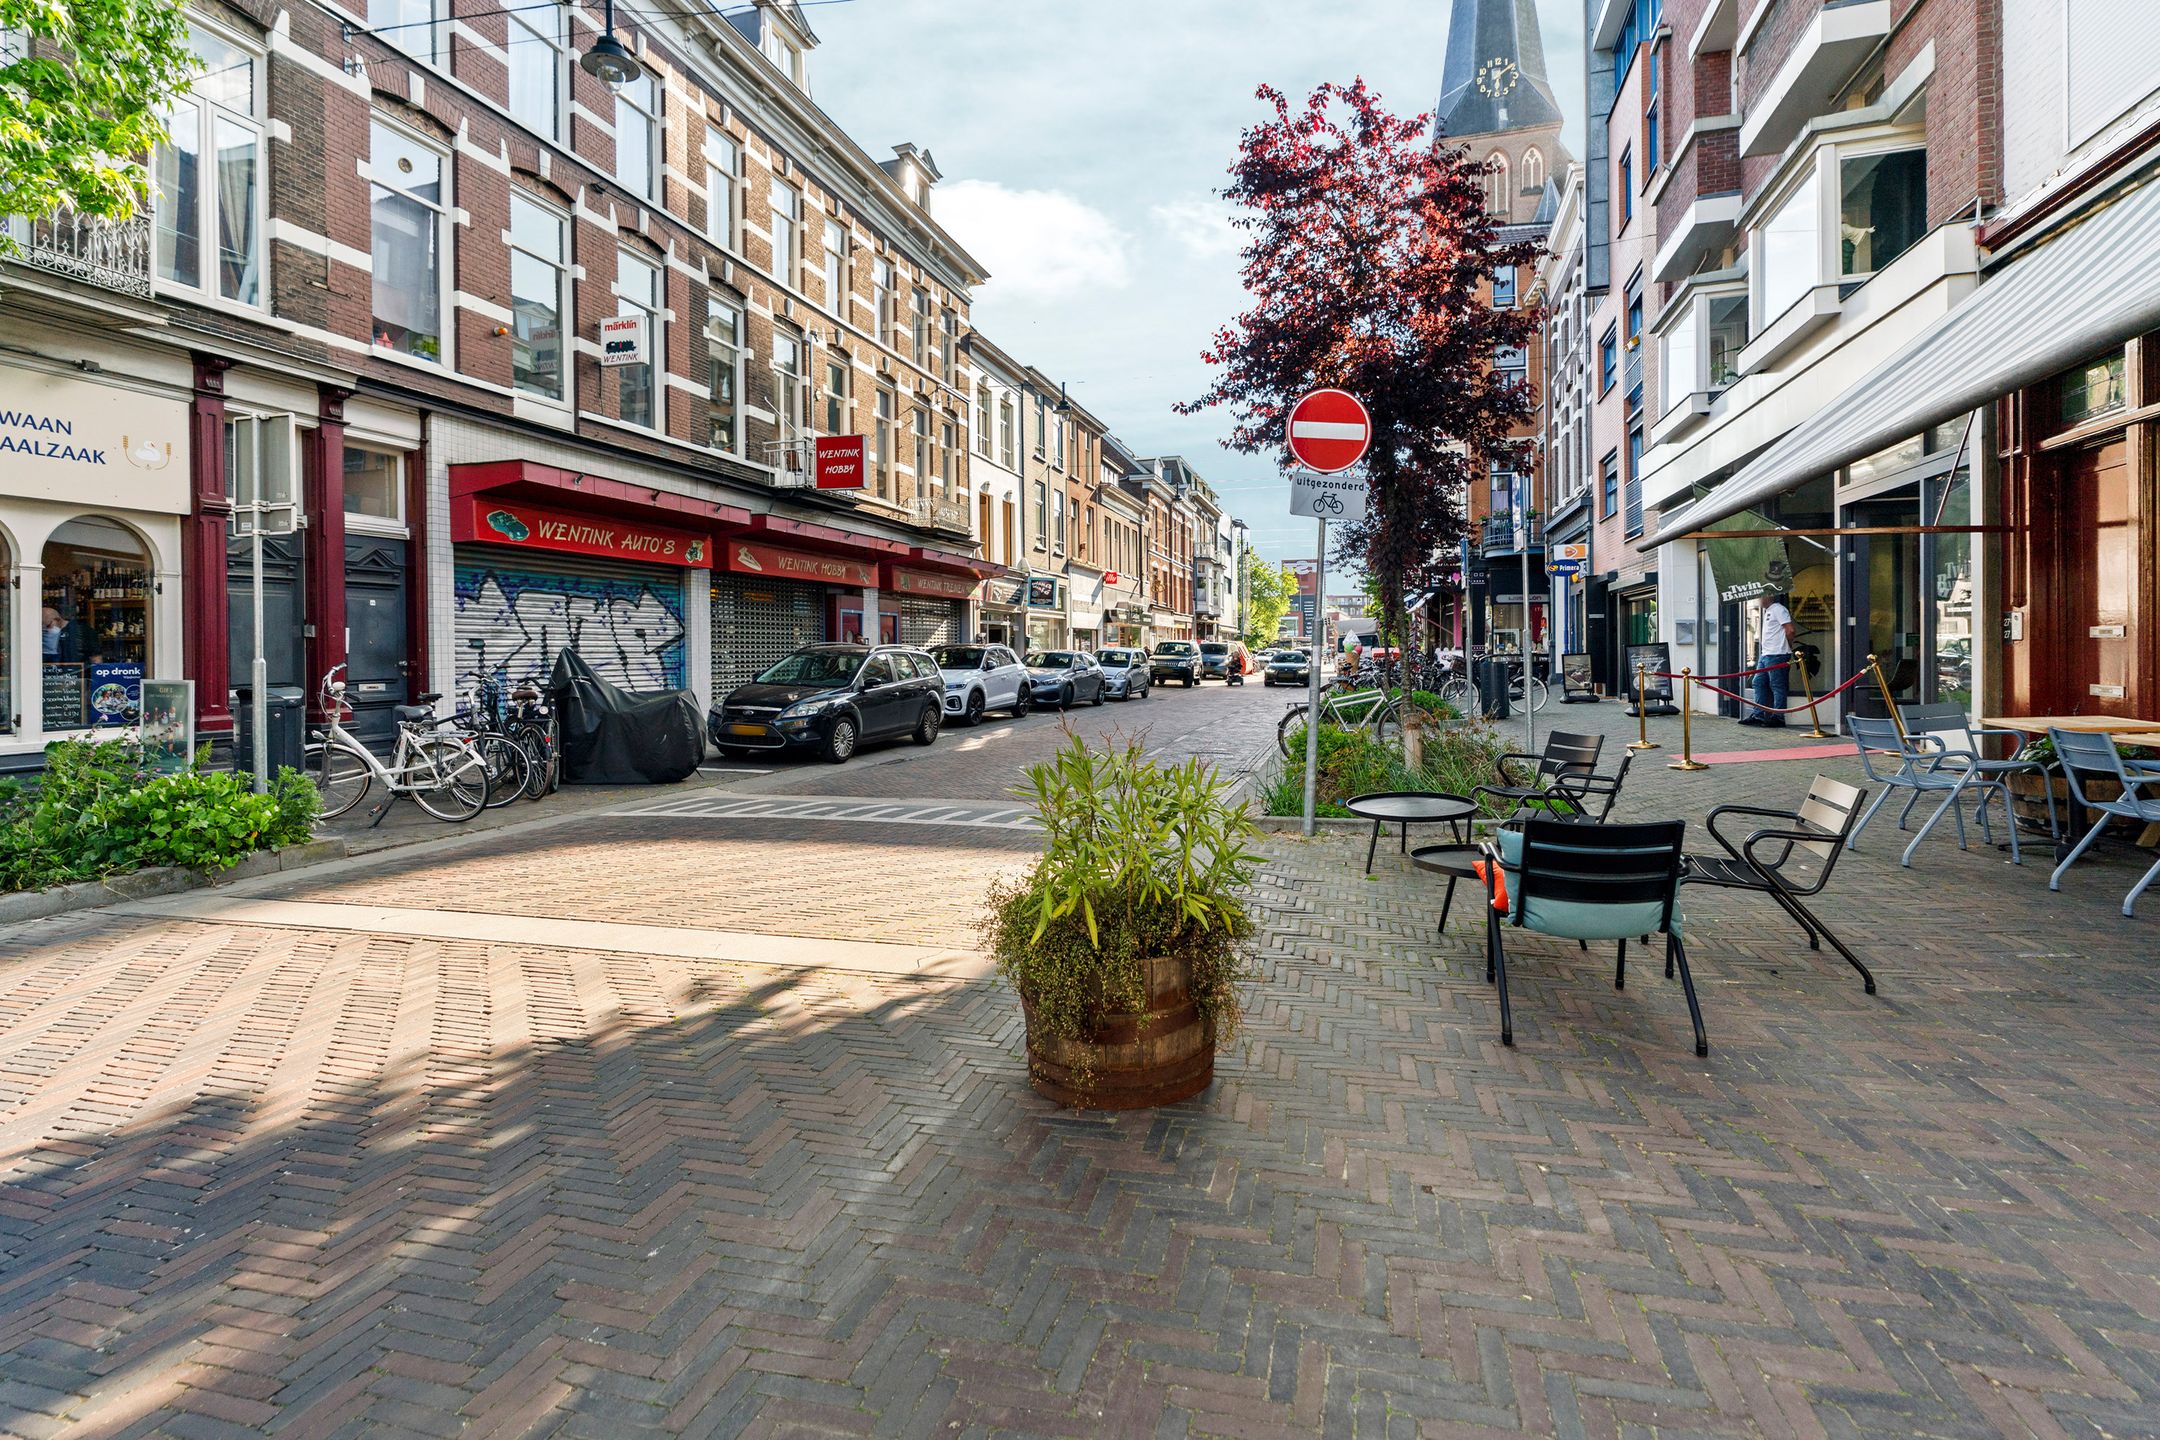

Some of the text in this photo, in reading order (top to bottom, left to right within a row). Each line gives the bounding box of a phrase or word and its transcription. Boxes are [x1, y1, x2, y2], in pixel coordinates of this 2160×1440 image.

[1487, 60, 1492, 68] 11
[1495, 57, 1502, 65] 12
[1477, 77, 1482, 85] 9
[1486, 90, 1492, 98] 7
[1503, 87, 1508, 95] 5
[604, 320, 637, 332] märklin
[603, 353, 639, 363] WENTINK
[819, 449, 860, 459] WENTINK
[825, 464, 855, 474] HOBBY
[1296, 477, 1365, 492] uitgezonderd
[538, 520, 675, 555] WENTINK AUTO'S
[778, 556, 846, 578] WENTINK HOBBY
[1560, 564, 1579, 572] Primera
[1106, 574, 1117, 582] illy
[918, 578, 942, 592] WENTINK
[1729, 581, 1761, 594] Twin
[2004, 630, 2011, 638] 27
[96, 667, 141, 677] op dronk
